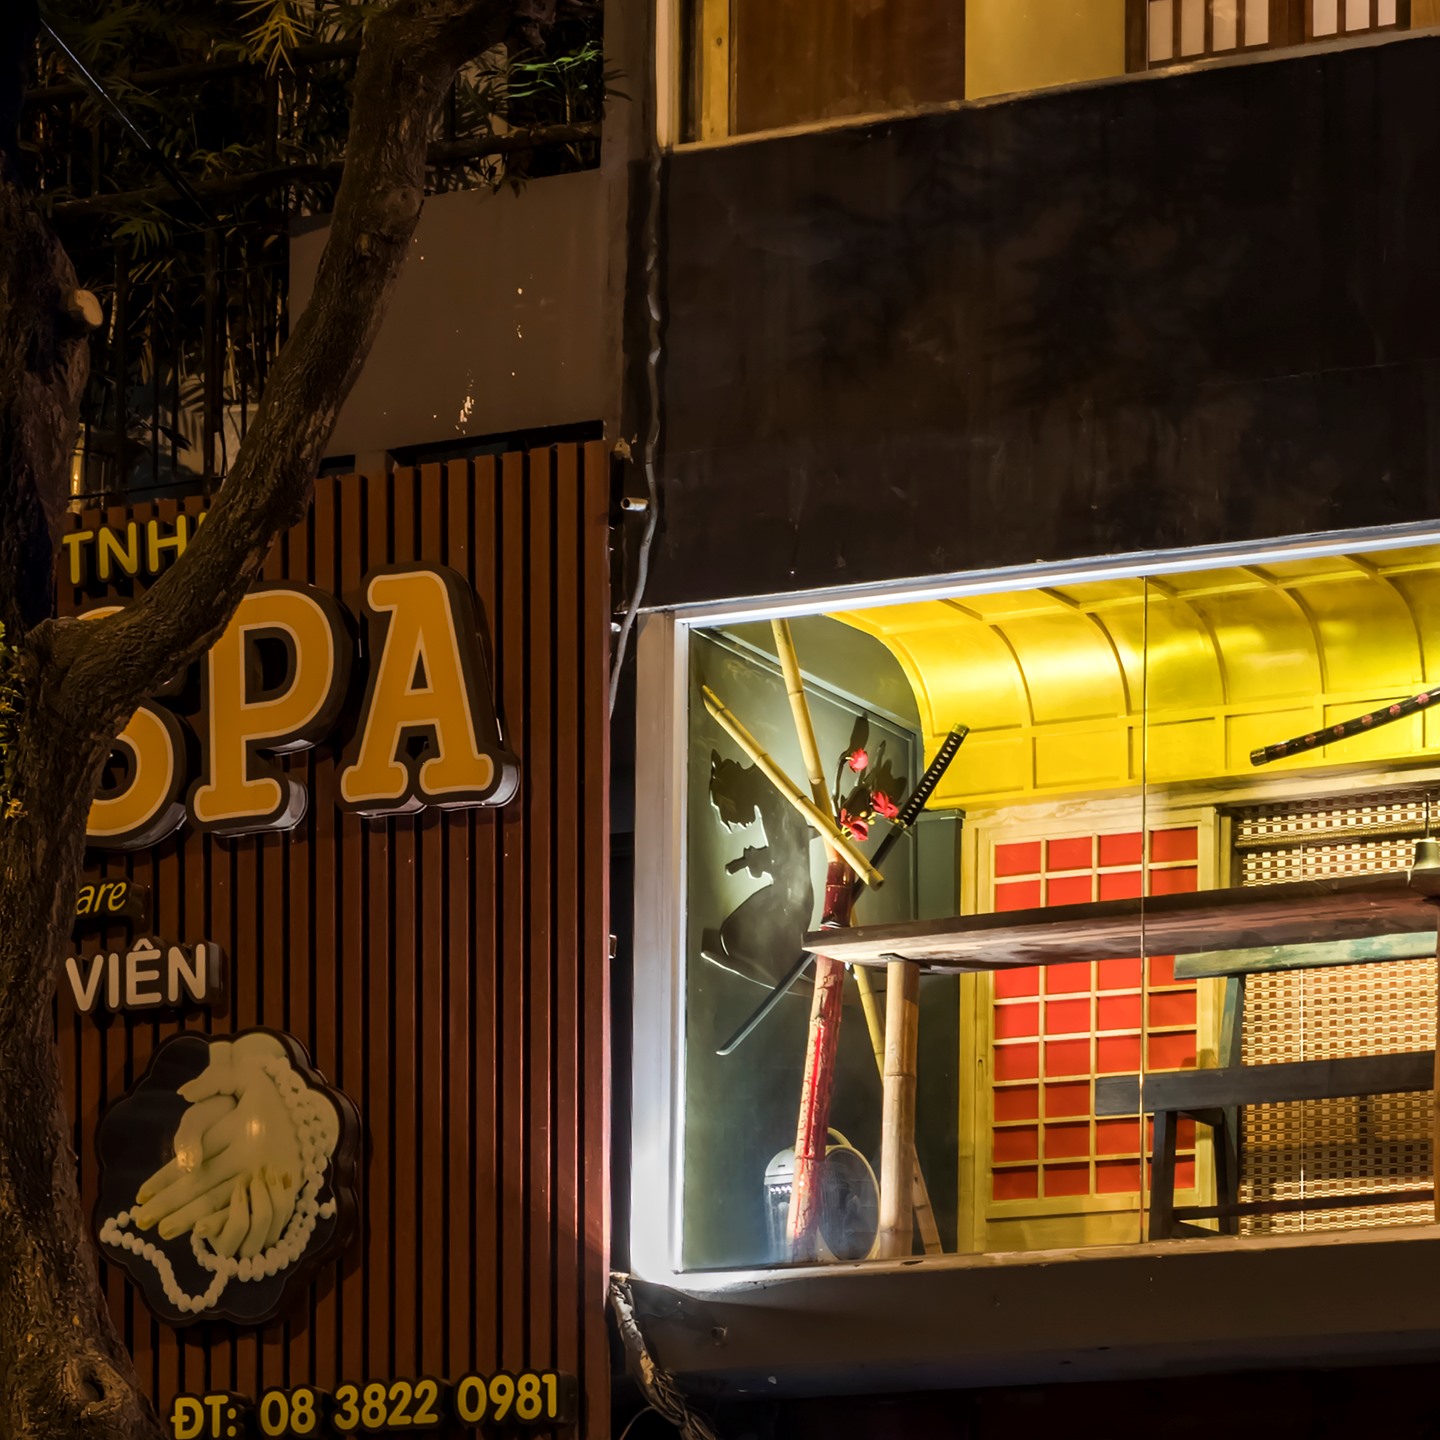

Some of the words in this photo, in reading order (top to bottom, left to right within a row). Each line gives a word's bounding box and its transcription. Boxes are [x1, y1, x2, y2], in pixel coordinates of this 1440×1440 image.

[62, 509, 208, 585] TNH
[65, 937, 208, 1013] VIÊN
[259, 1384, 316, 1440] 08
[332, 1377, 440, 1433] 3822
[457, 1370, 560, 1426] 0981
